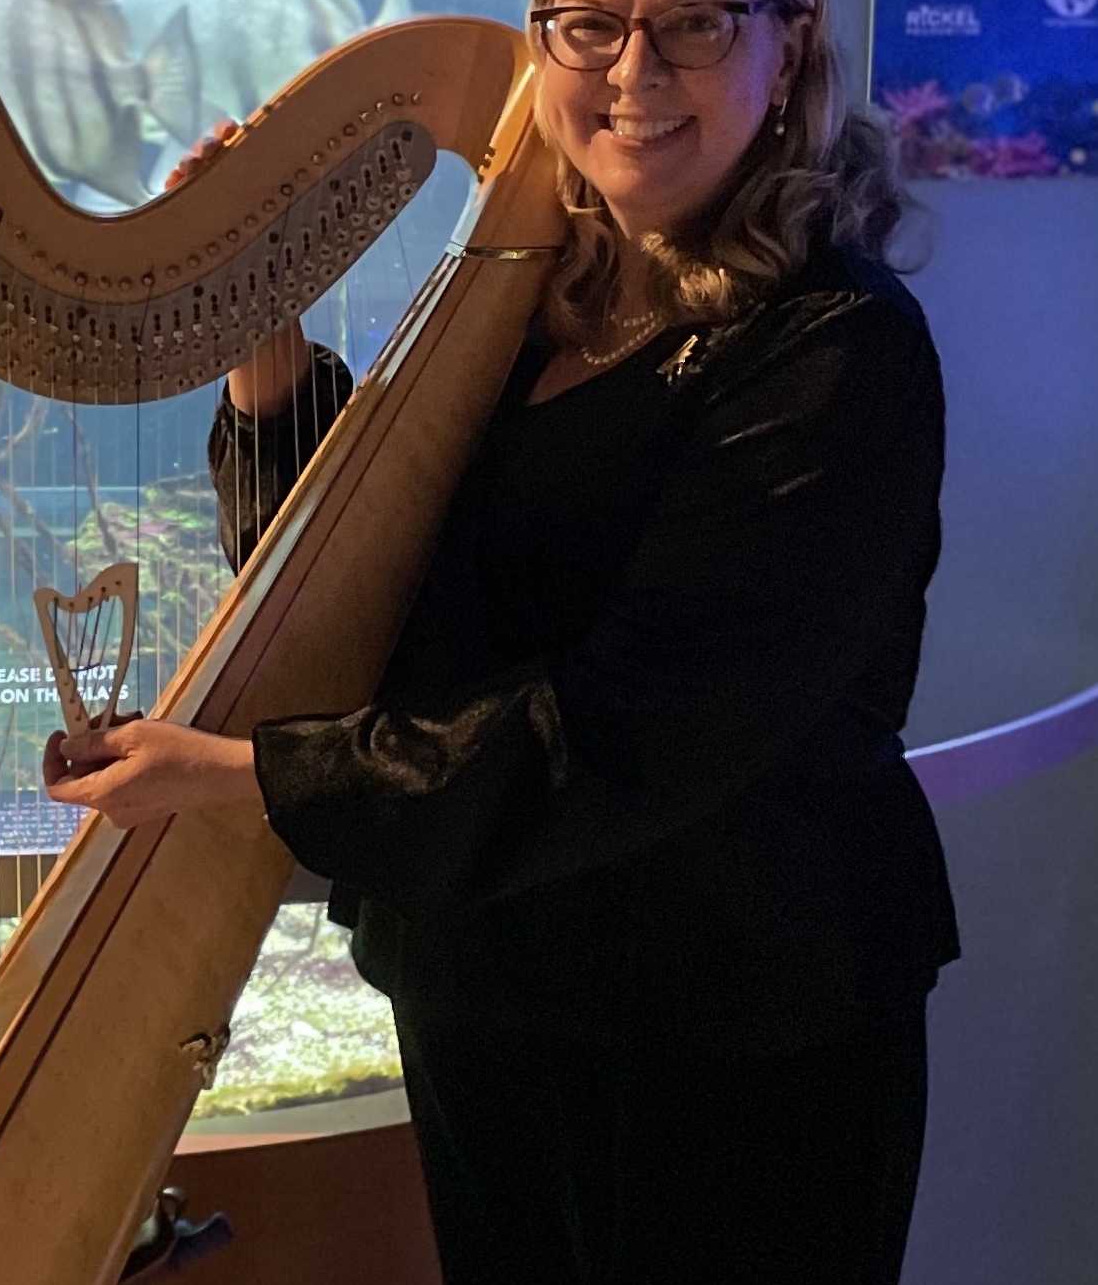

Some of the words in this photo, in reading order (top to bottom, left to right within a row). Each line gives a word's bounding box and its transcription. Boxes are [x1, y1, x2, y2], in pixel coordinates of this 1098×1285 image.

[0, 688, 30, 704] ON
[33, 688, 62, 704] TH
[77, 684, 129, 702] GLAS
